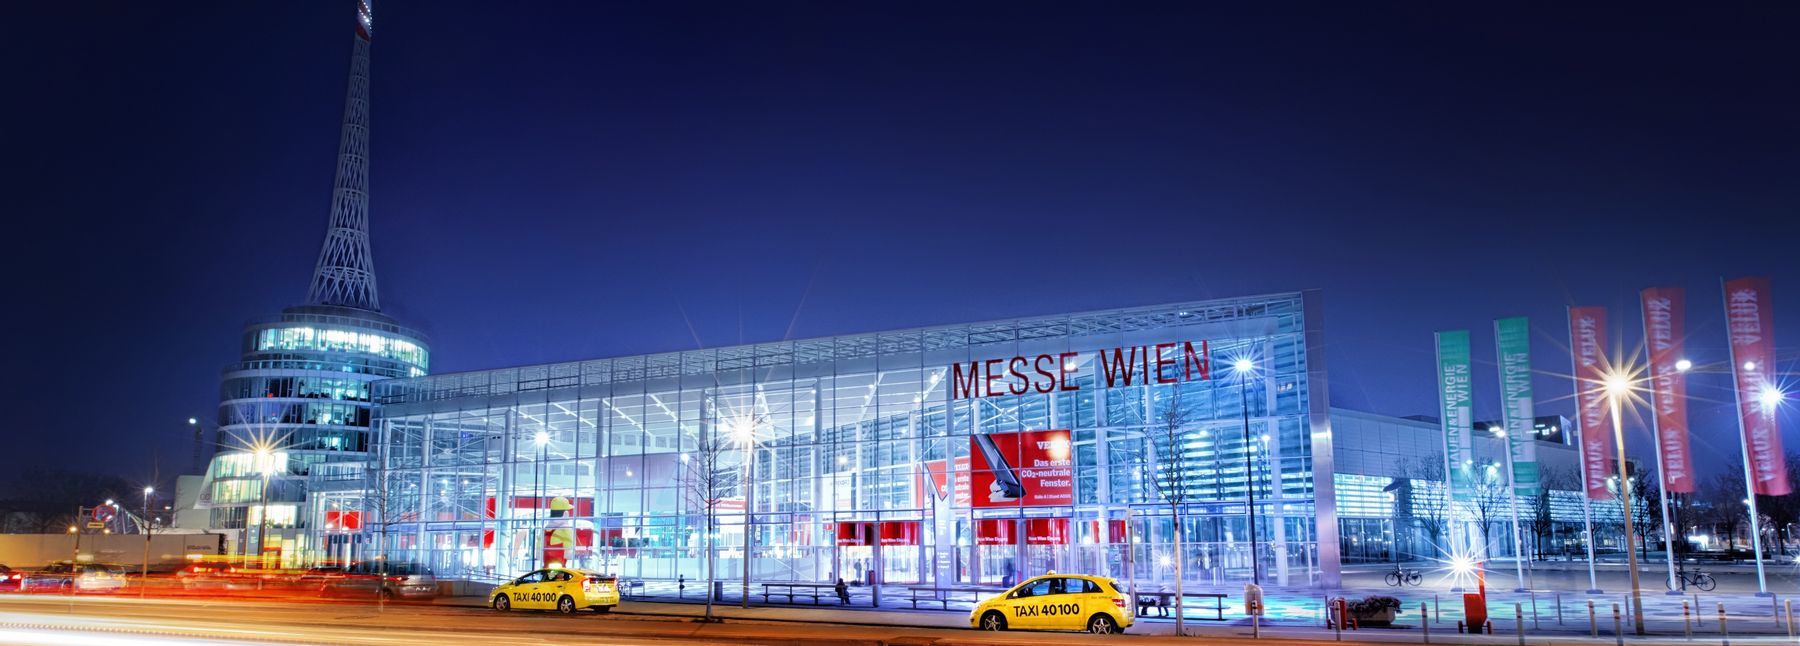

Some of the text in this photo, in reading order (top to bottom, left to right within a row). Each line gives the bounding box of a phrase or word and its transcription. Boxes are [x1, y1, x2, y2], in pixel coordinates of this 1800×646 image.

[1579, 315, 1598, 367] VELUX
[1648, 298, 1672, 351] VELUX
[952, 339, 1210, 401] MESSE WIEN
[1456, 363, 1469, 402] WIEN
[1515, 352, 1531, 394] WIEN
[1034, 459, 1049, 467] Das
[1040, 479, 1072, 487] Fenster.
[1587, 440, 1604, 490] VELUX
[513, 592, 530, 603] TAXI
[1013, 604, 1039, 617] TAXI
